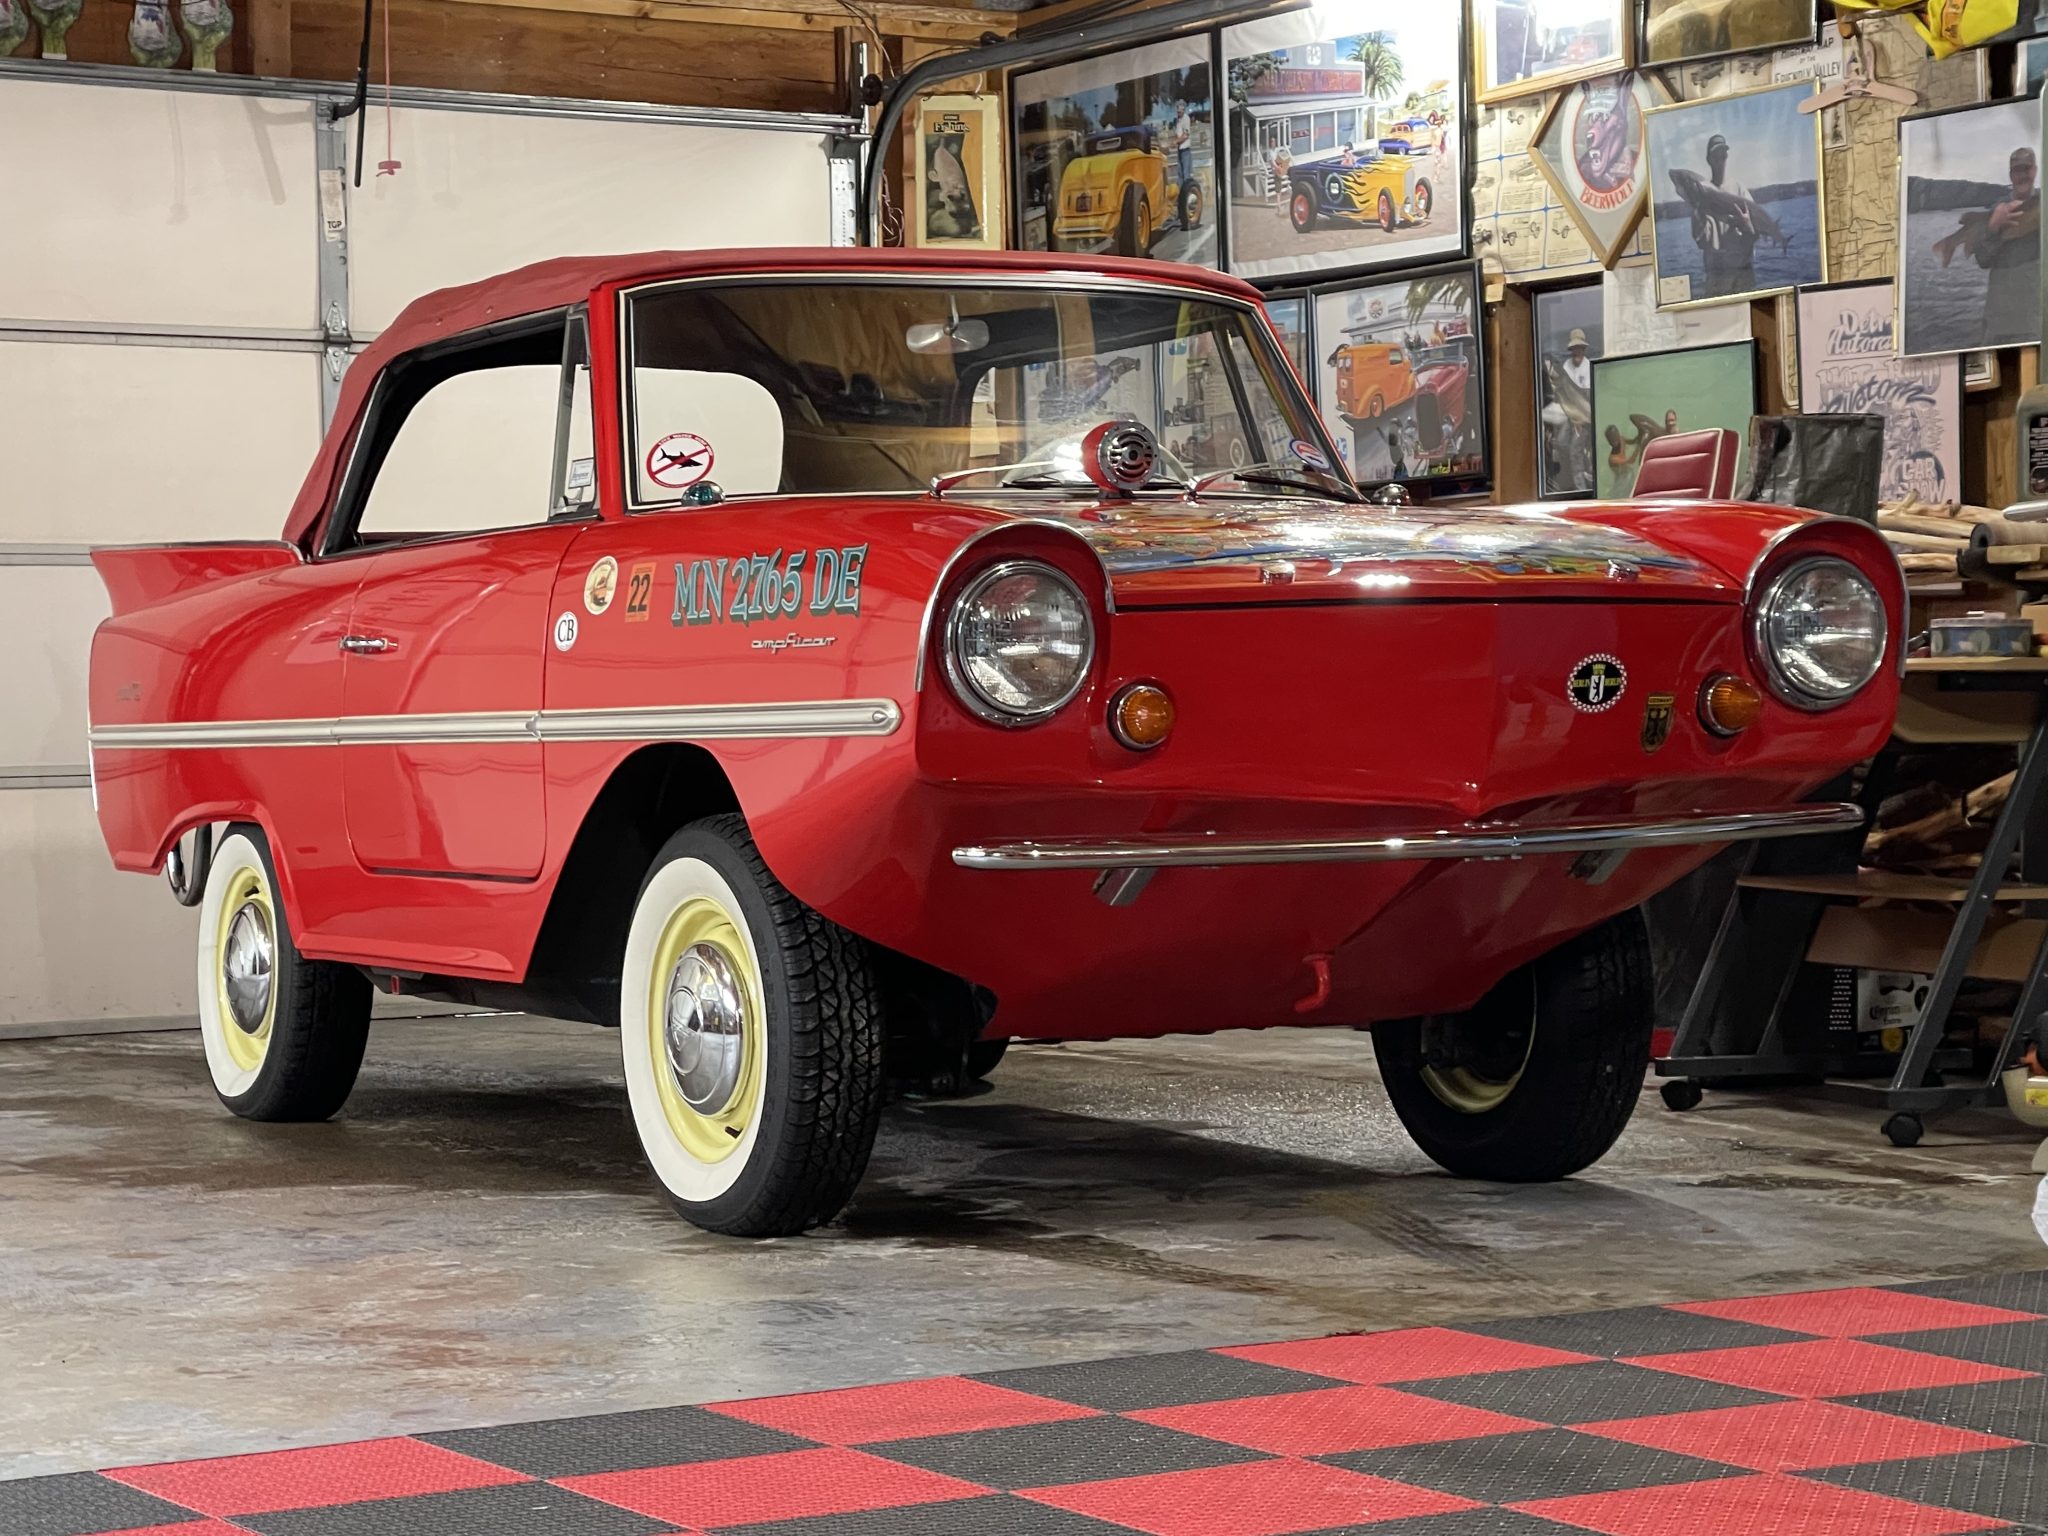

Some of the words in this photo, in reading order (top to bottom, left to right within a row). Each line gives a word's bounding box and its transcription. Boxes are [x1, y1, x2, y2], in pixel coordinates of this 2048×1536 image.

[1813, 61, 1841, 78] VALLEY
[1839, 309, 1892, 335] Detr
[1902, 457, 1938, 480] CAR
[626, 573, 651, 613] 22
[671, 558, 729, 626] MN
[730, 547, 807, 627] 2765
[809, 542, 869, 617] DE
[557, 618, 575, 643] CB
